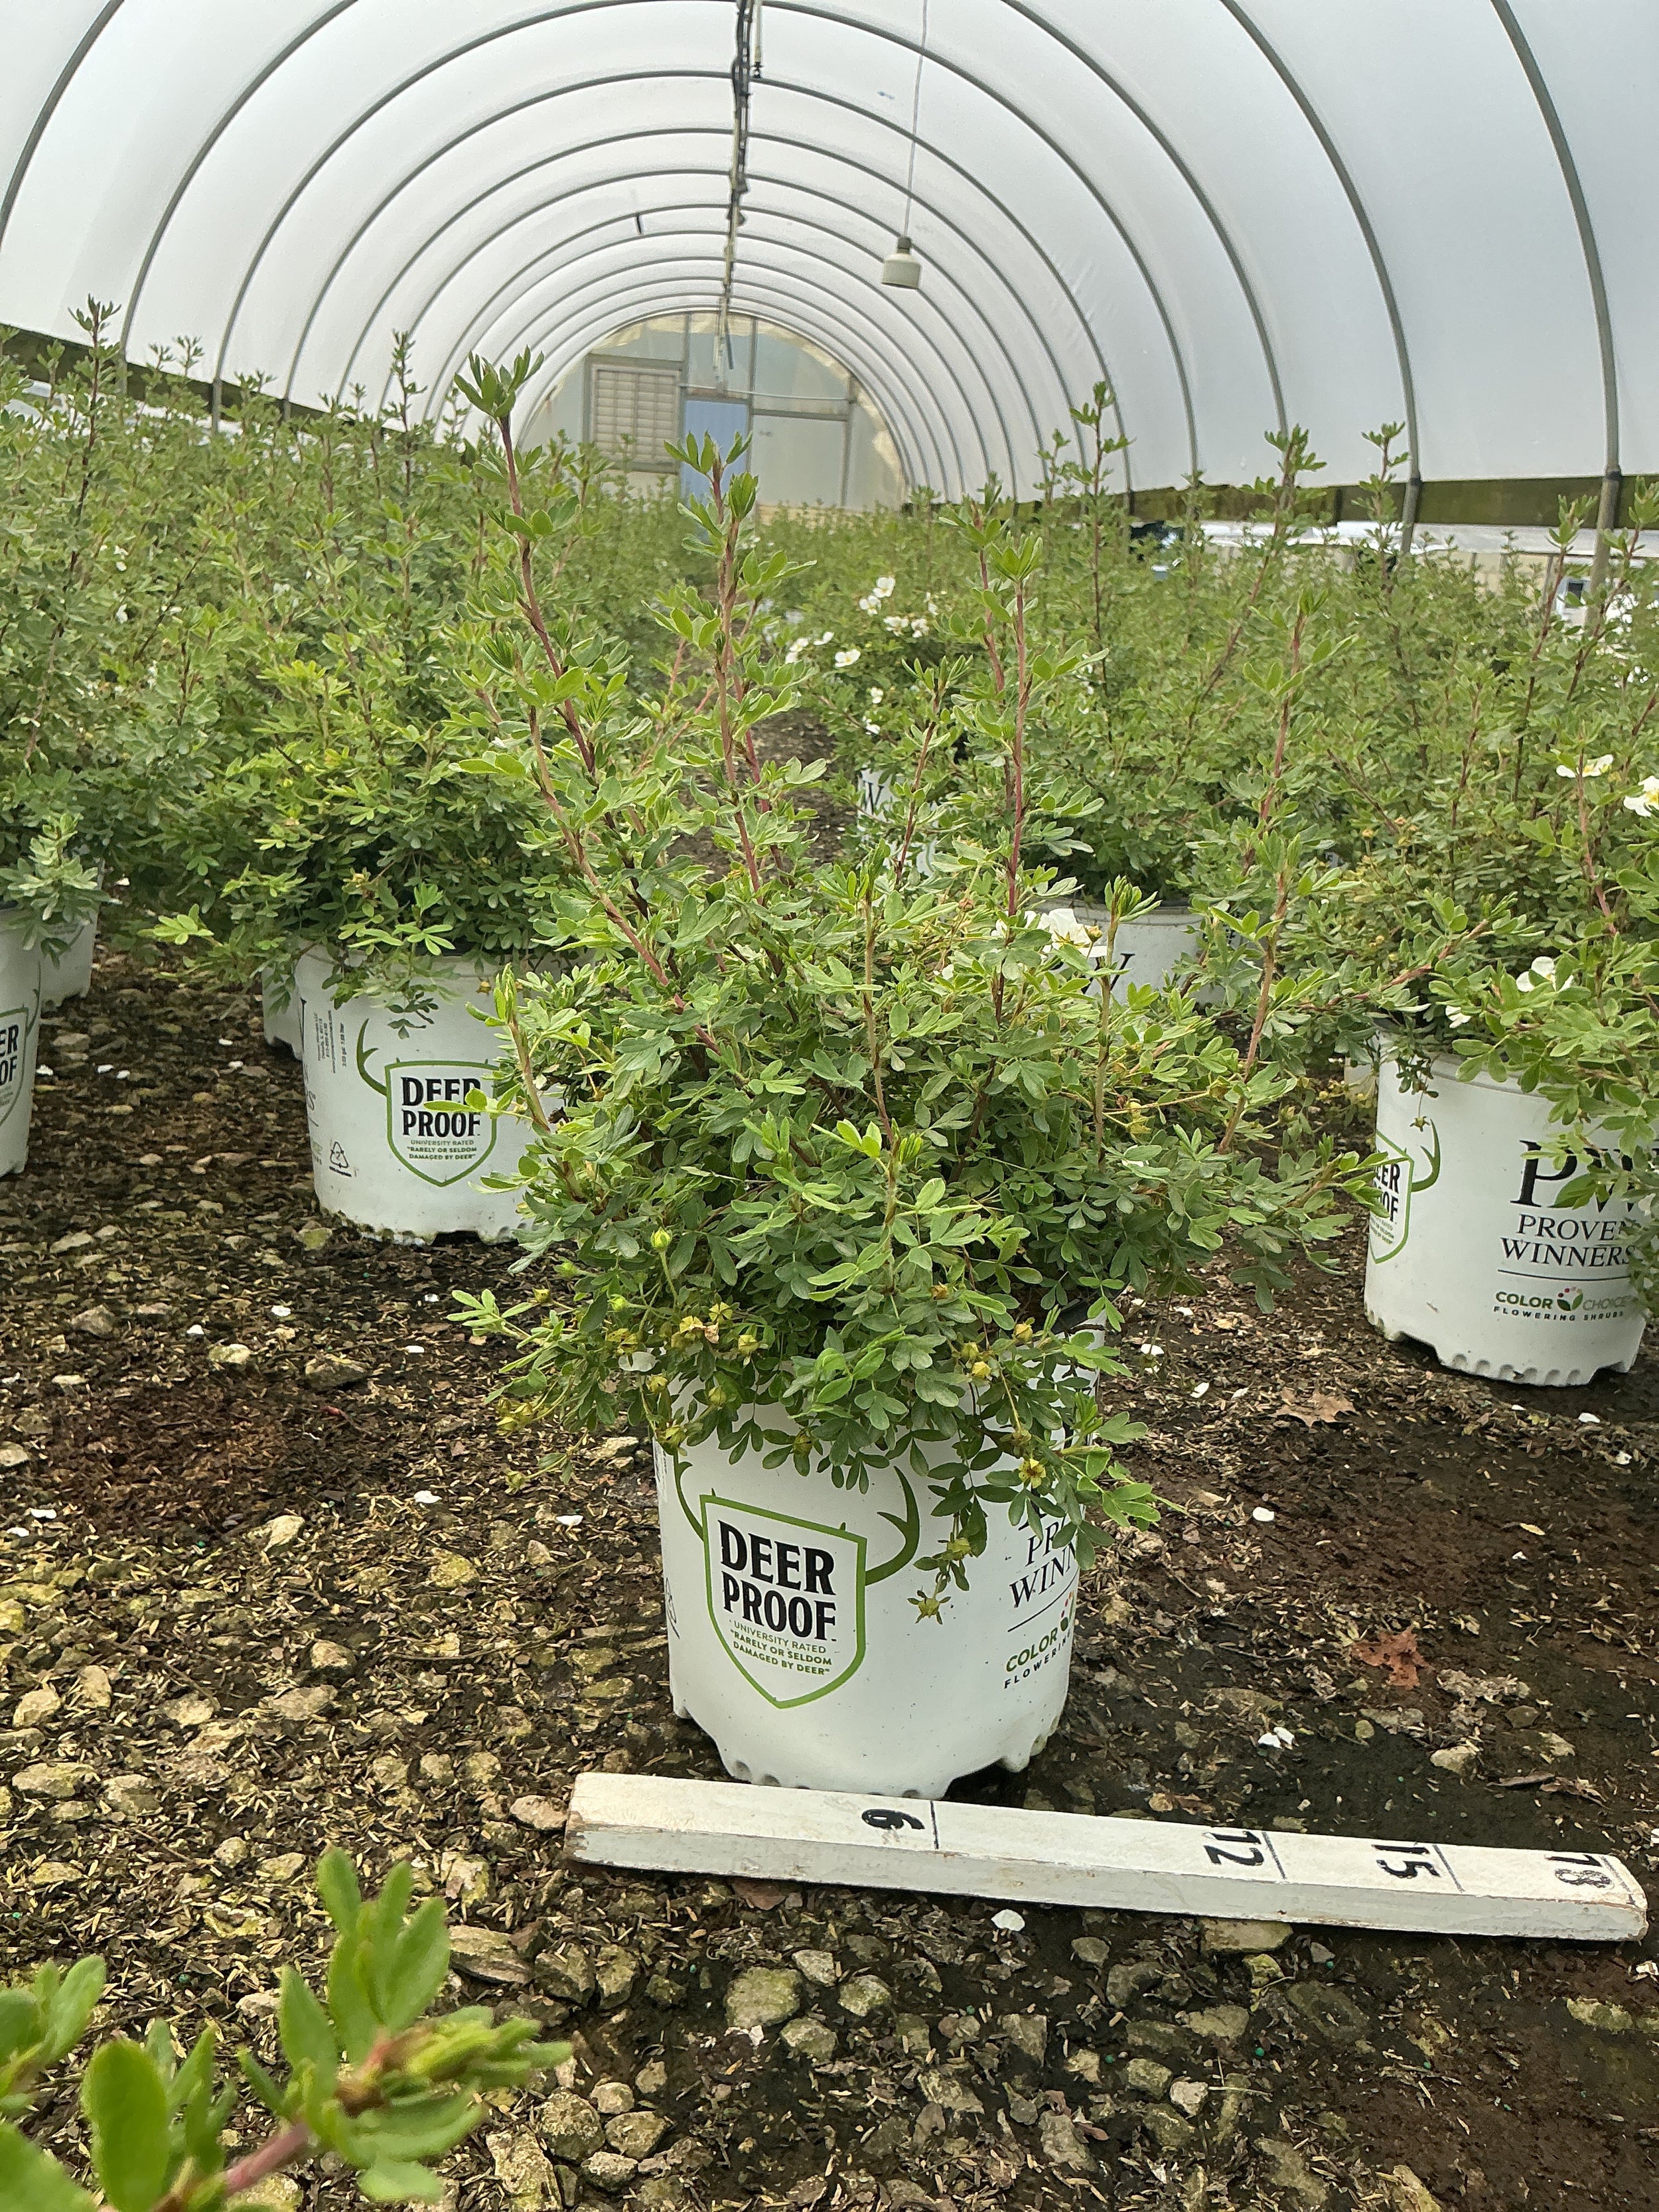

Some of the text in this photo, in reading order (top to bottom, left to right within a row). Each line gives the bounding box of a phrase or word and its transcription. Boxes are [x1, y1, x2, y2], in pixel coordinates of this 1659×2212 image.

[401, 1109, 480, 1137] PROOF
[1500, 1236, 1636, 1267] WINNERS
[1494, 1305, 1624, 1321] FLOWERING SHRUBS
[1495, 1291, 1553, 1309] COLOR
[717, 1519, 836, 1595] DEER
[721, 1570, 836, 1641] PROOF
[730, 1629, 832, 1666] "RARELY OR SELDOM
[733, 1620, 827, 1654] UNIVERSITY RATED
[1006, 1627, 1058, 1673] COLOR
[733, 1641, 830, 1676] DAMAGED BY DEER"
[861, 1808, 925, 1830] 6
[1202, 1830, 1264, 1866] 12
[1371, 1844, 1441, 1878] 15
[1544, 1854, 1613, 1889] 18
